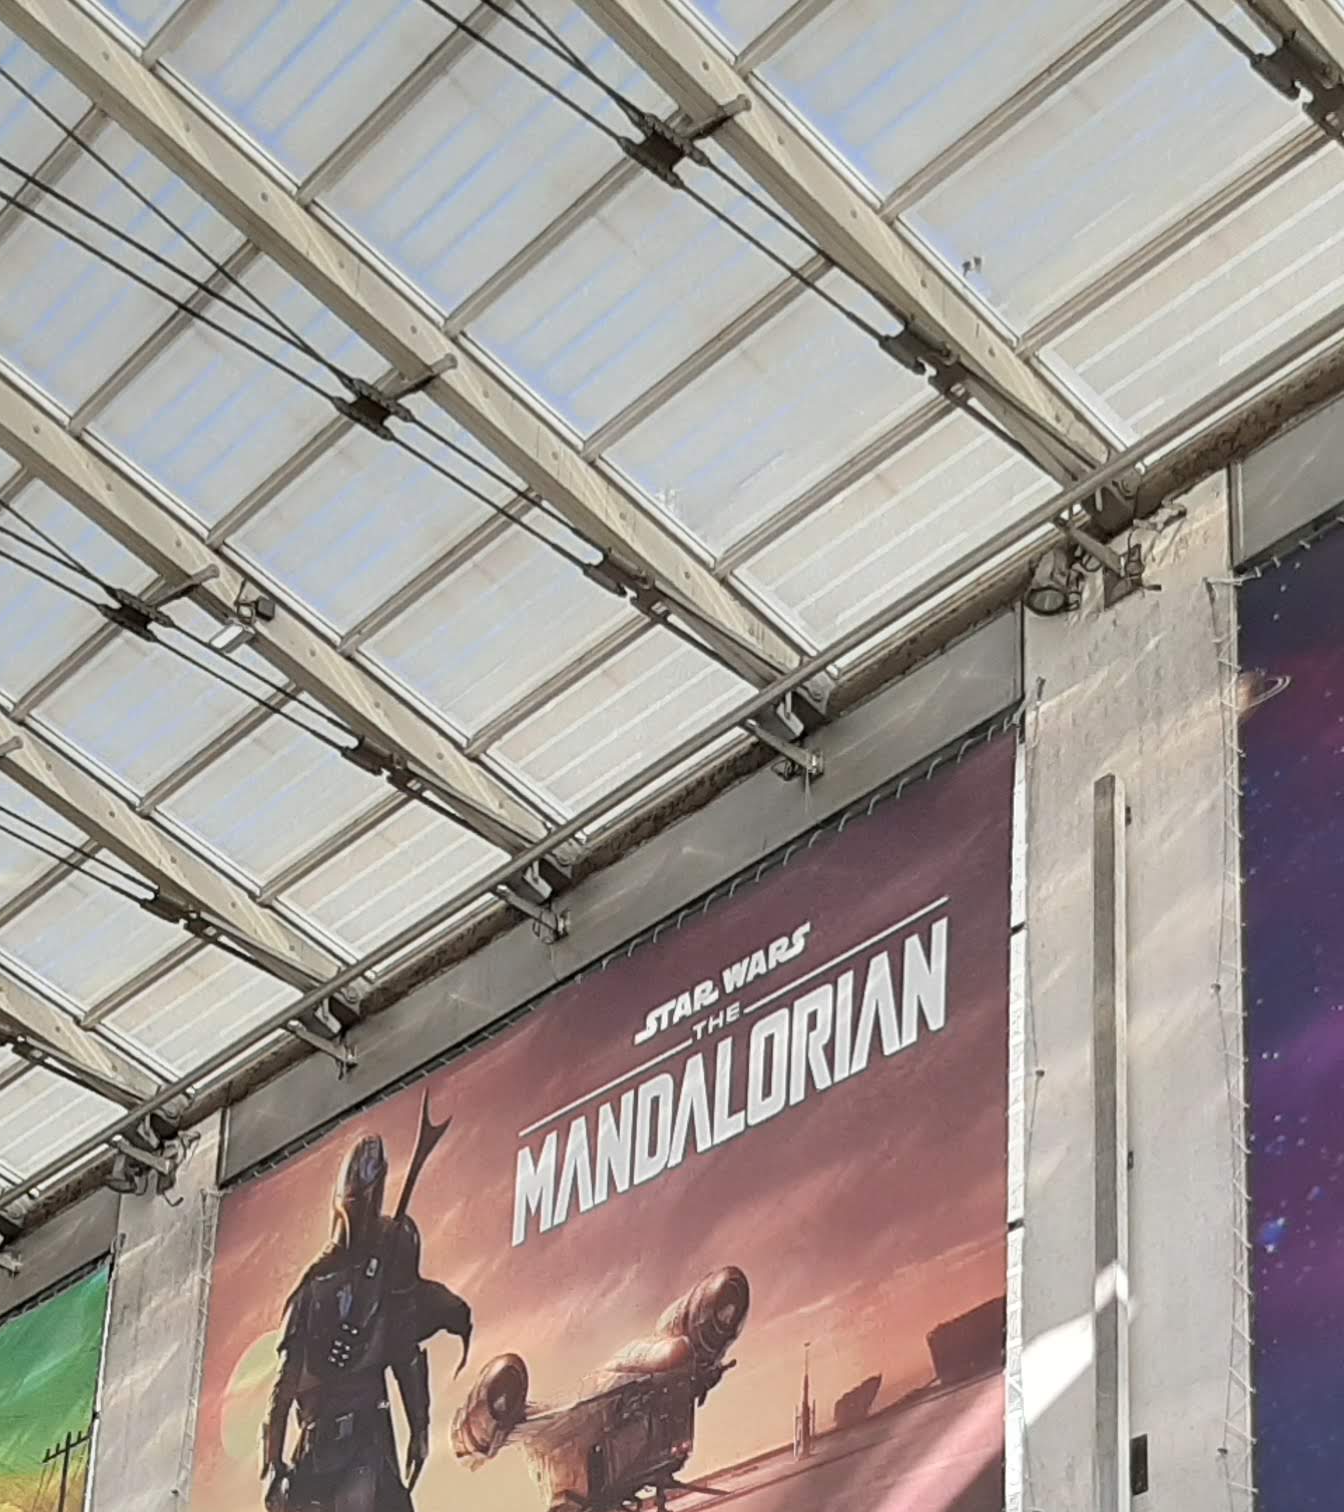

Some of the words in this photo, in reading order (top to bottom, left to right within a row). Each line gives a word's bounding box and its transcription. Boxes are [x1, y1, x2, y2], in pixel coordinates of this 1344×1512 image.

[634, 978, 720, 1045] STAR
[722, 921, 811, 994] WARS
[692, 1002, 743, 1040] THE
[511, 916, 949, 1248] MANDALORIAN
